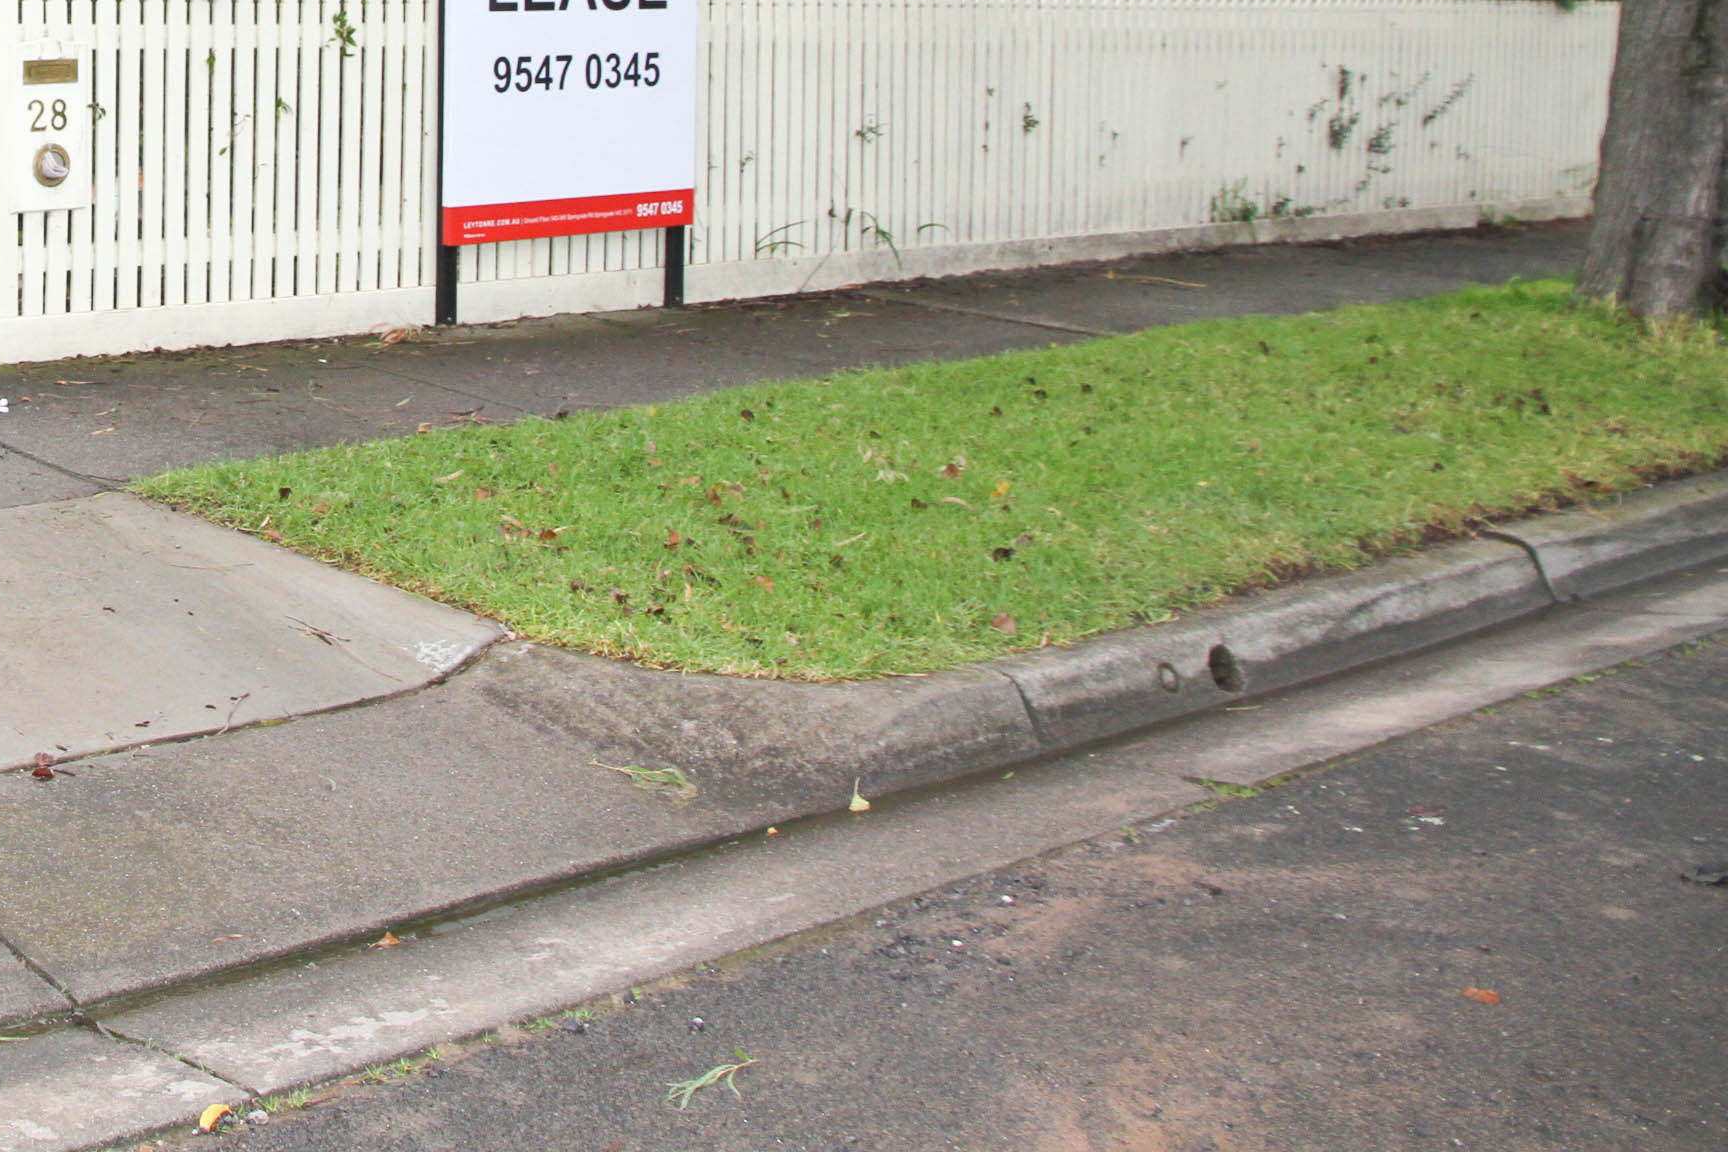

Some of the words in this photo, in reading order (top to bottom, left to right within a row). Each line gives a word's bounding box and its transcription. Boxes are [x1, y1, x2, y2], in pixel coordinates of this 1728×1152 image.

[493, 54, 573, 94] 9547
[584, 51, 661, 90] 0345
[27, 98, 68, 132] 28
[636, 201, 660, 218] 9547
[660, 199, 684, 216] 0345
